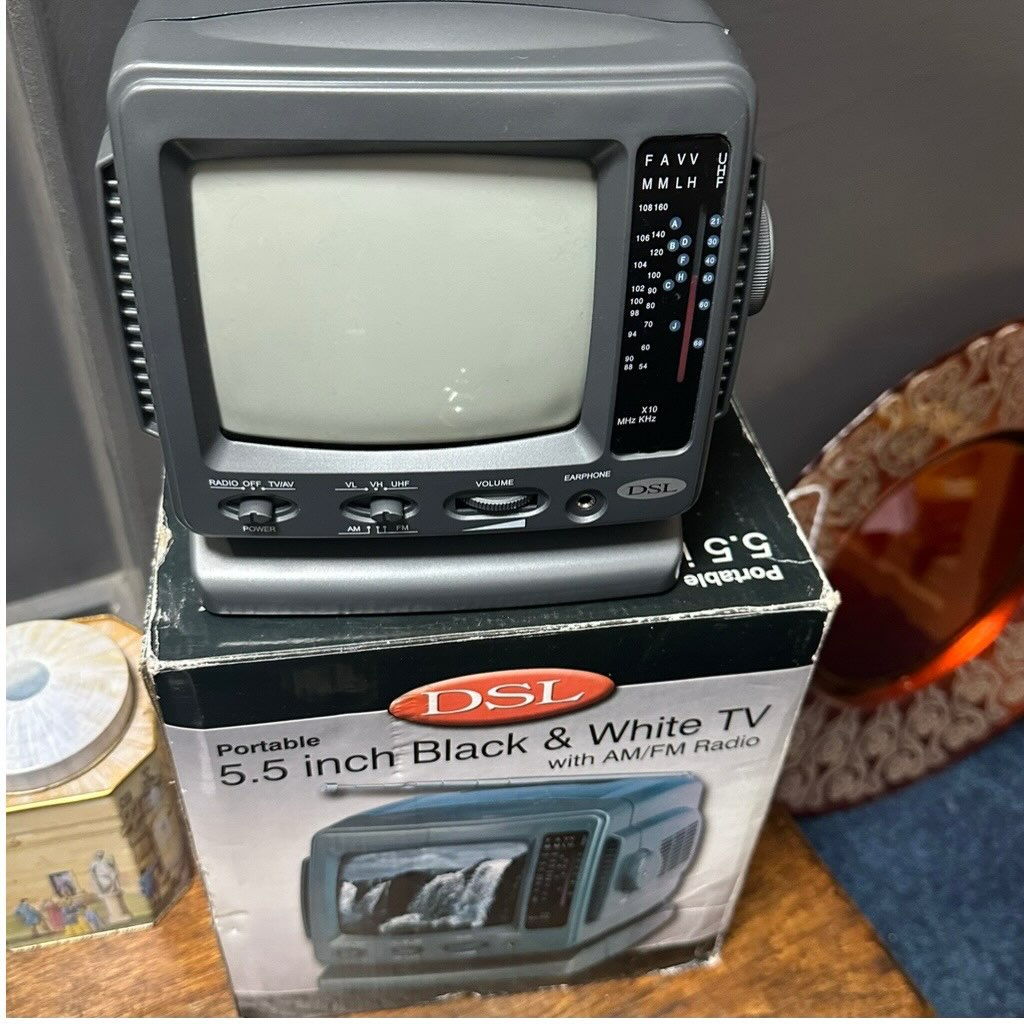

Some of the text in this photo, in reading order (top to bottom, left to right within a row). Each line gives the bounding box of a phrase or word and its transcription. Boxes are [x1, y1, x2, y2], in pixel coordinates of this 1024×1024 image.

[639, 204, 653, 212] 108
[654, 202, 669, 211] 160
[636, 234, 650, 242] 106
[651, 230, 666, 238] 140
[650, 248, 664, 256] 120
[634, 261, 647, 269] 104
[647, 271, 661, 279] 100
[647, 287, 657, 295] 90
[646, 302, 656, 310] 80
[625, 355, 635, 363] 90
[617, 415, 657, 425] MHz KHz
[564, 470, 611, 481] EARPHONE
[208, 479, 294, 488] RADIO OFF TV/AV
[391, 480, 410, 488] UHF
[476, 479, 514, 488] VOLUME
[627, 483, 678, 496] DSL
[243, 525, 276, 533] POWER
[396, 524, 409, 532] FM
[704, 532, 773, 564] 5.5
[684, 565, 784, 588] Portable
[421, 679, 586, 717] DSL
[216, 735, 320, 756] Portable
[219, 704, 772, 786] 5.5 inch Black & White TV
[548, 735, 760, 769] with AM/FM Radio
